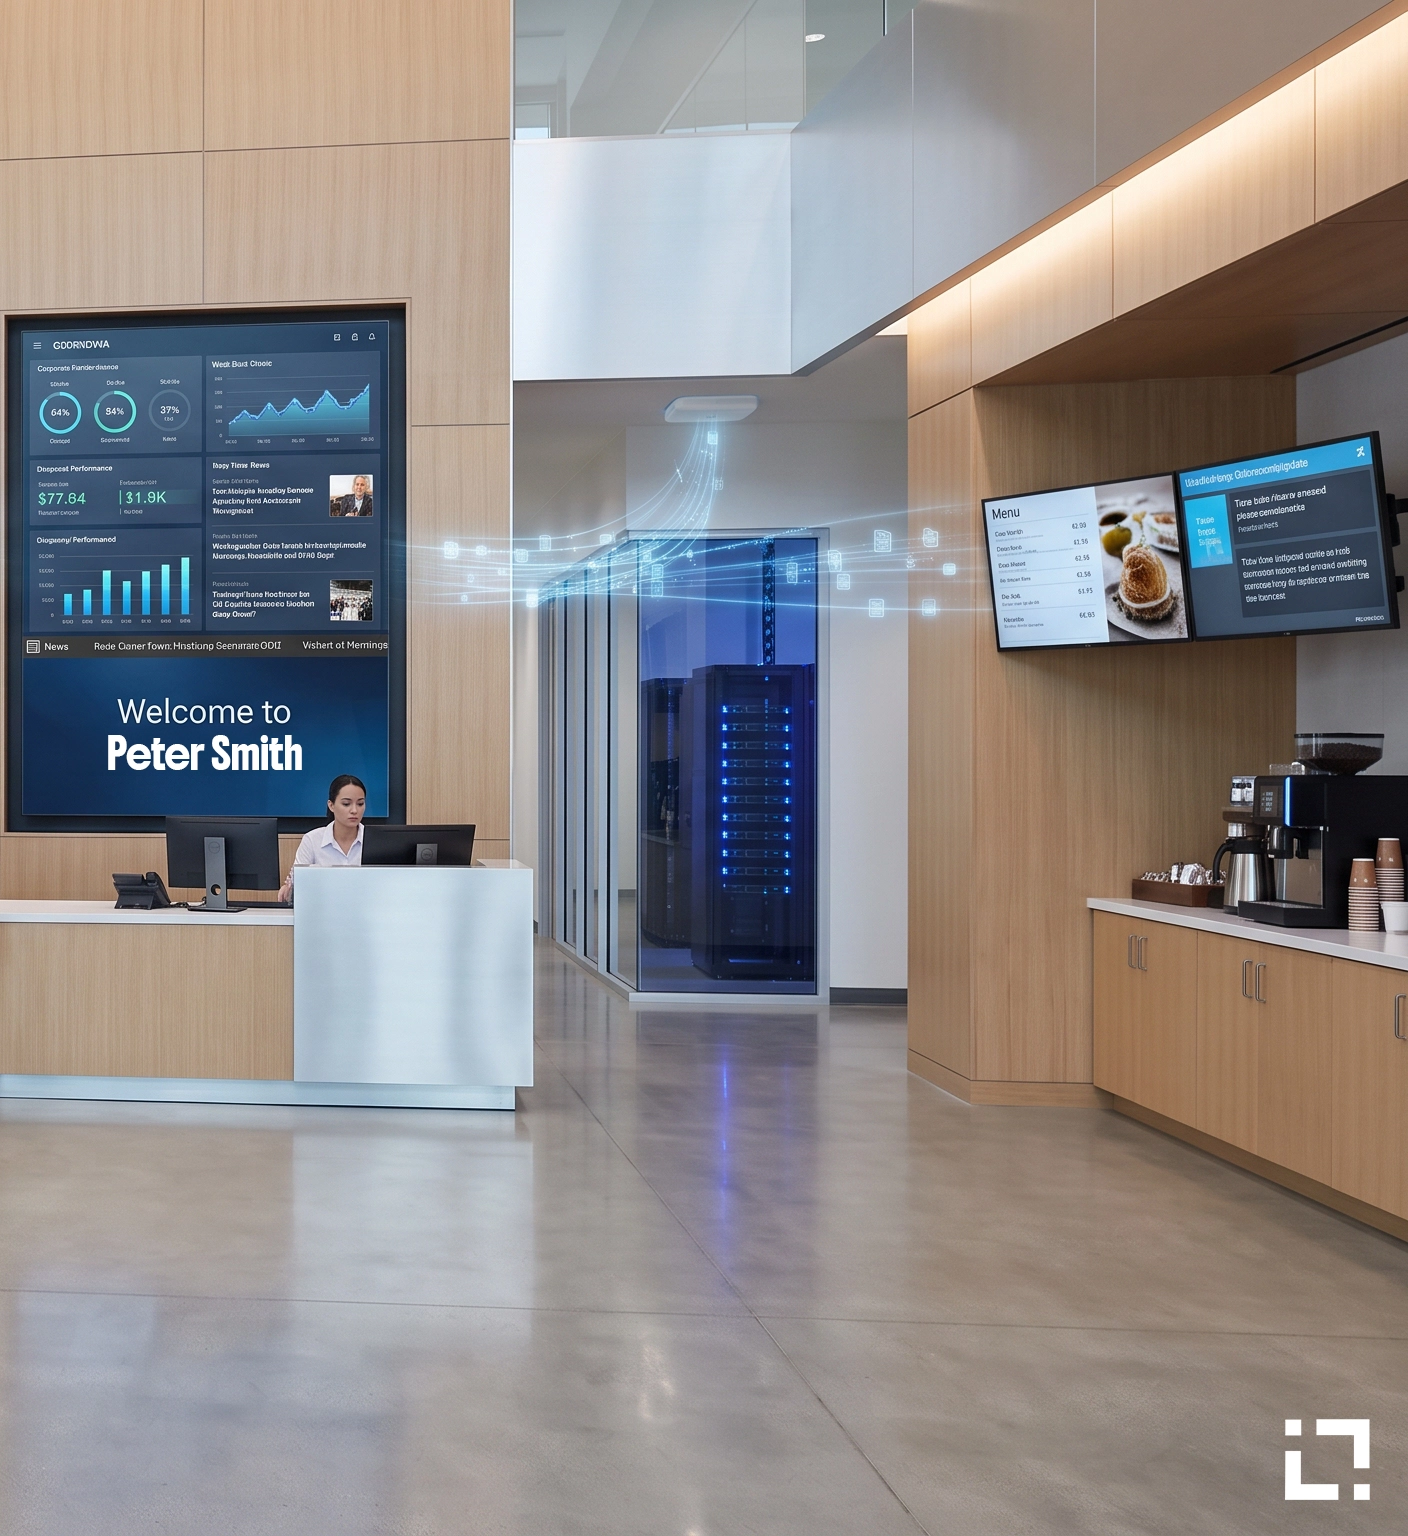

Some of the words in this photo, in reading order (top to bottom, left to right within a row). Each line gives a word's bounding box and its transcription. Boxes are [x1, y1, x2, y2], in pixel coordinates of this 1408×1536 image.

[992, 508, 1020, 520] Menu
[44, 642, 69, 651] News
[117, 697, 254, 725] Welcome
[261, 701, 292, 725] to
[107, 734, 205, 771] Peter
[211, 733, 303, 771] Smith
